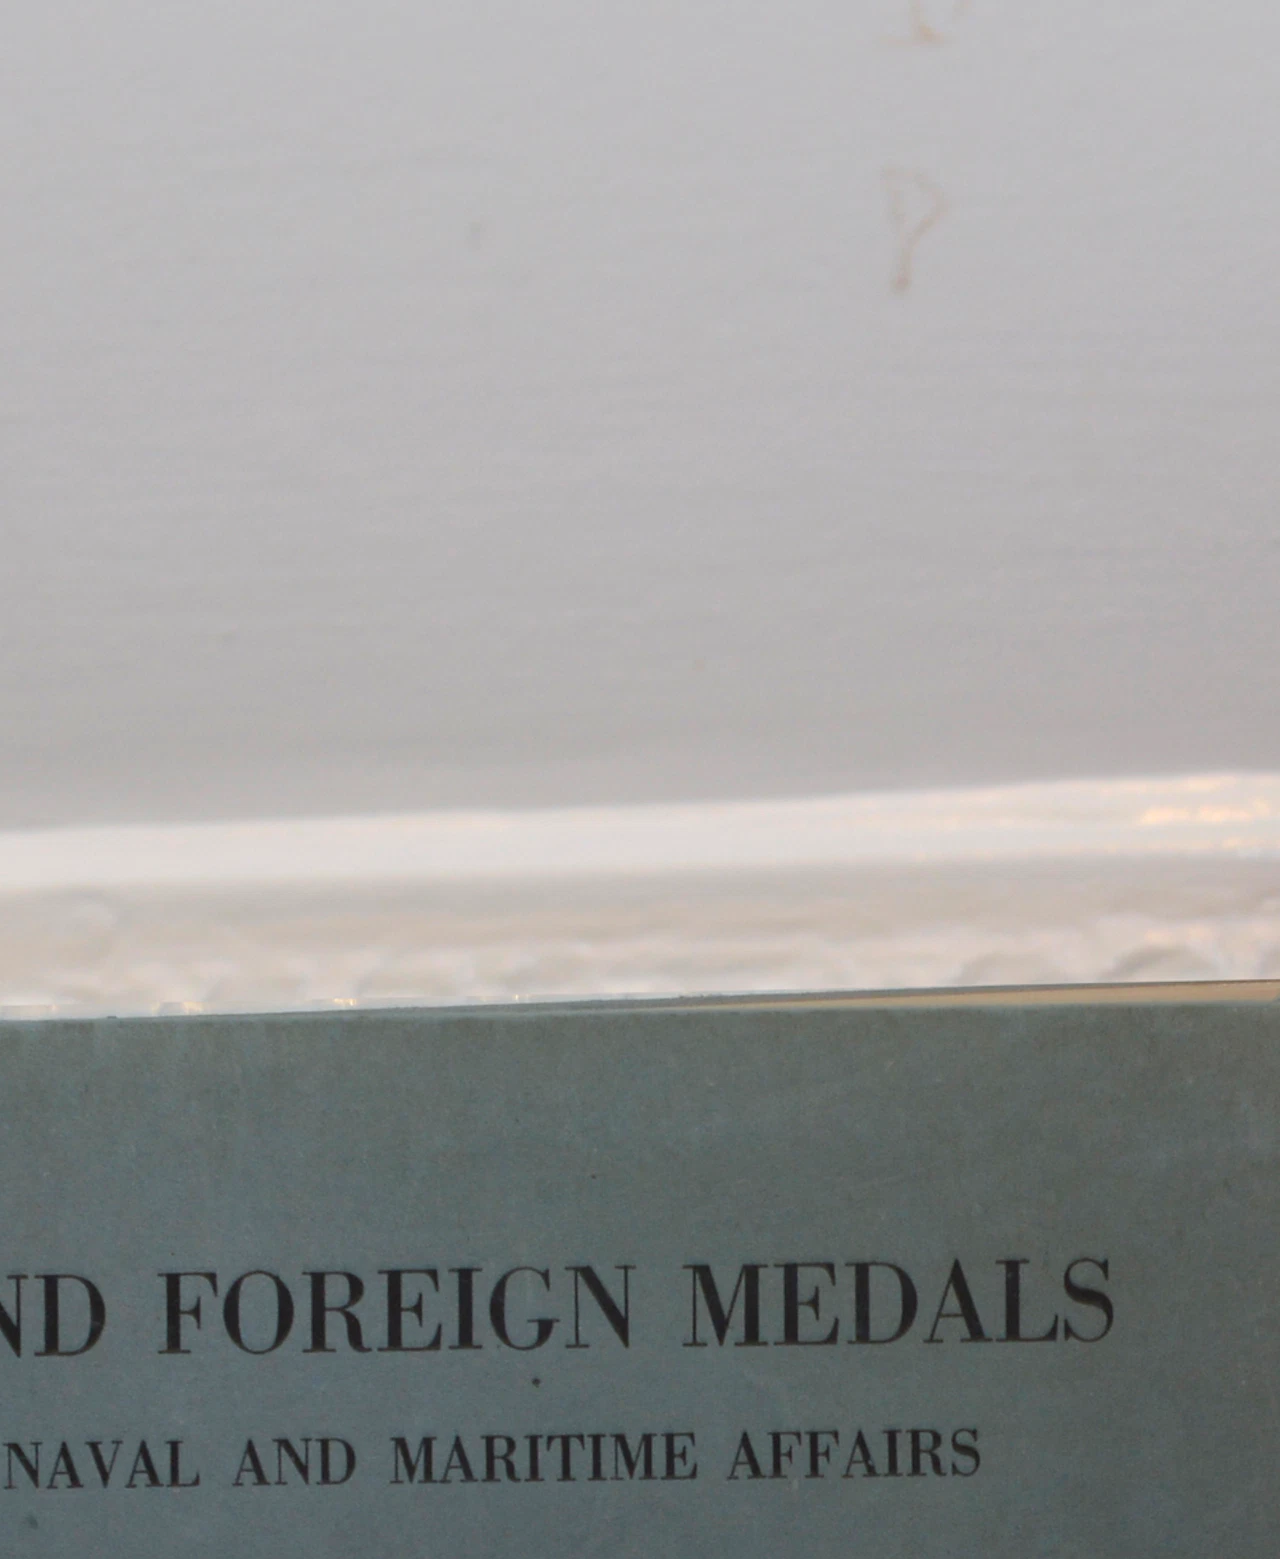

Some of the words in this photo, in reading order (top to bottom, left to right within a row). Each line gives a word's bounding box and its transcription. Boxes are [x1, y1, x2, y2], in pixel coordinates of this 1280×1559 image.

[157, 1264, 634, 1355] FOREIGN
[682, 1257, 1115, 1347] MEDALS
[3, 1439, 201, 1490] NAVAL
[232, 1436, 356, 1486] AND
[389, 1430, 698, 1485] MARITIME
[726, 1426, 981, 1480] AFFAIRS
